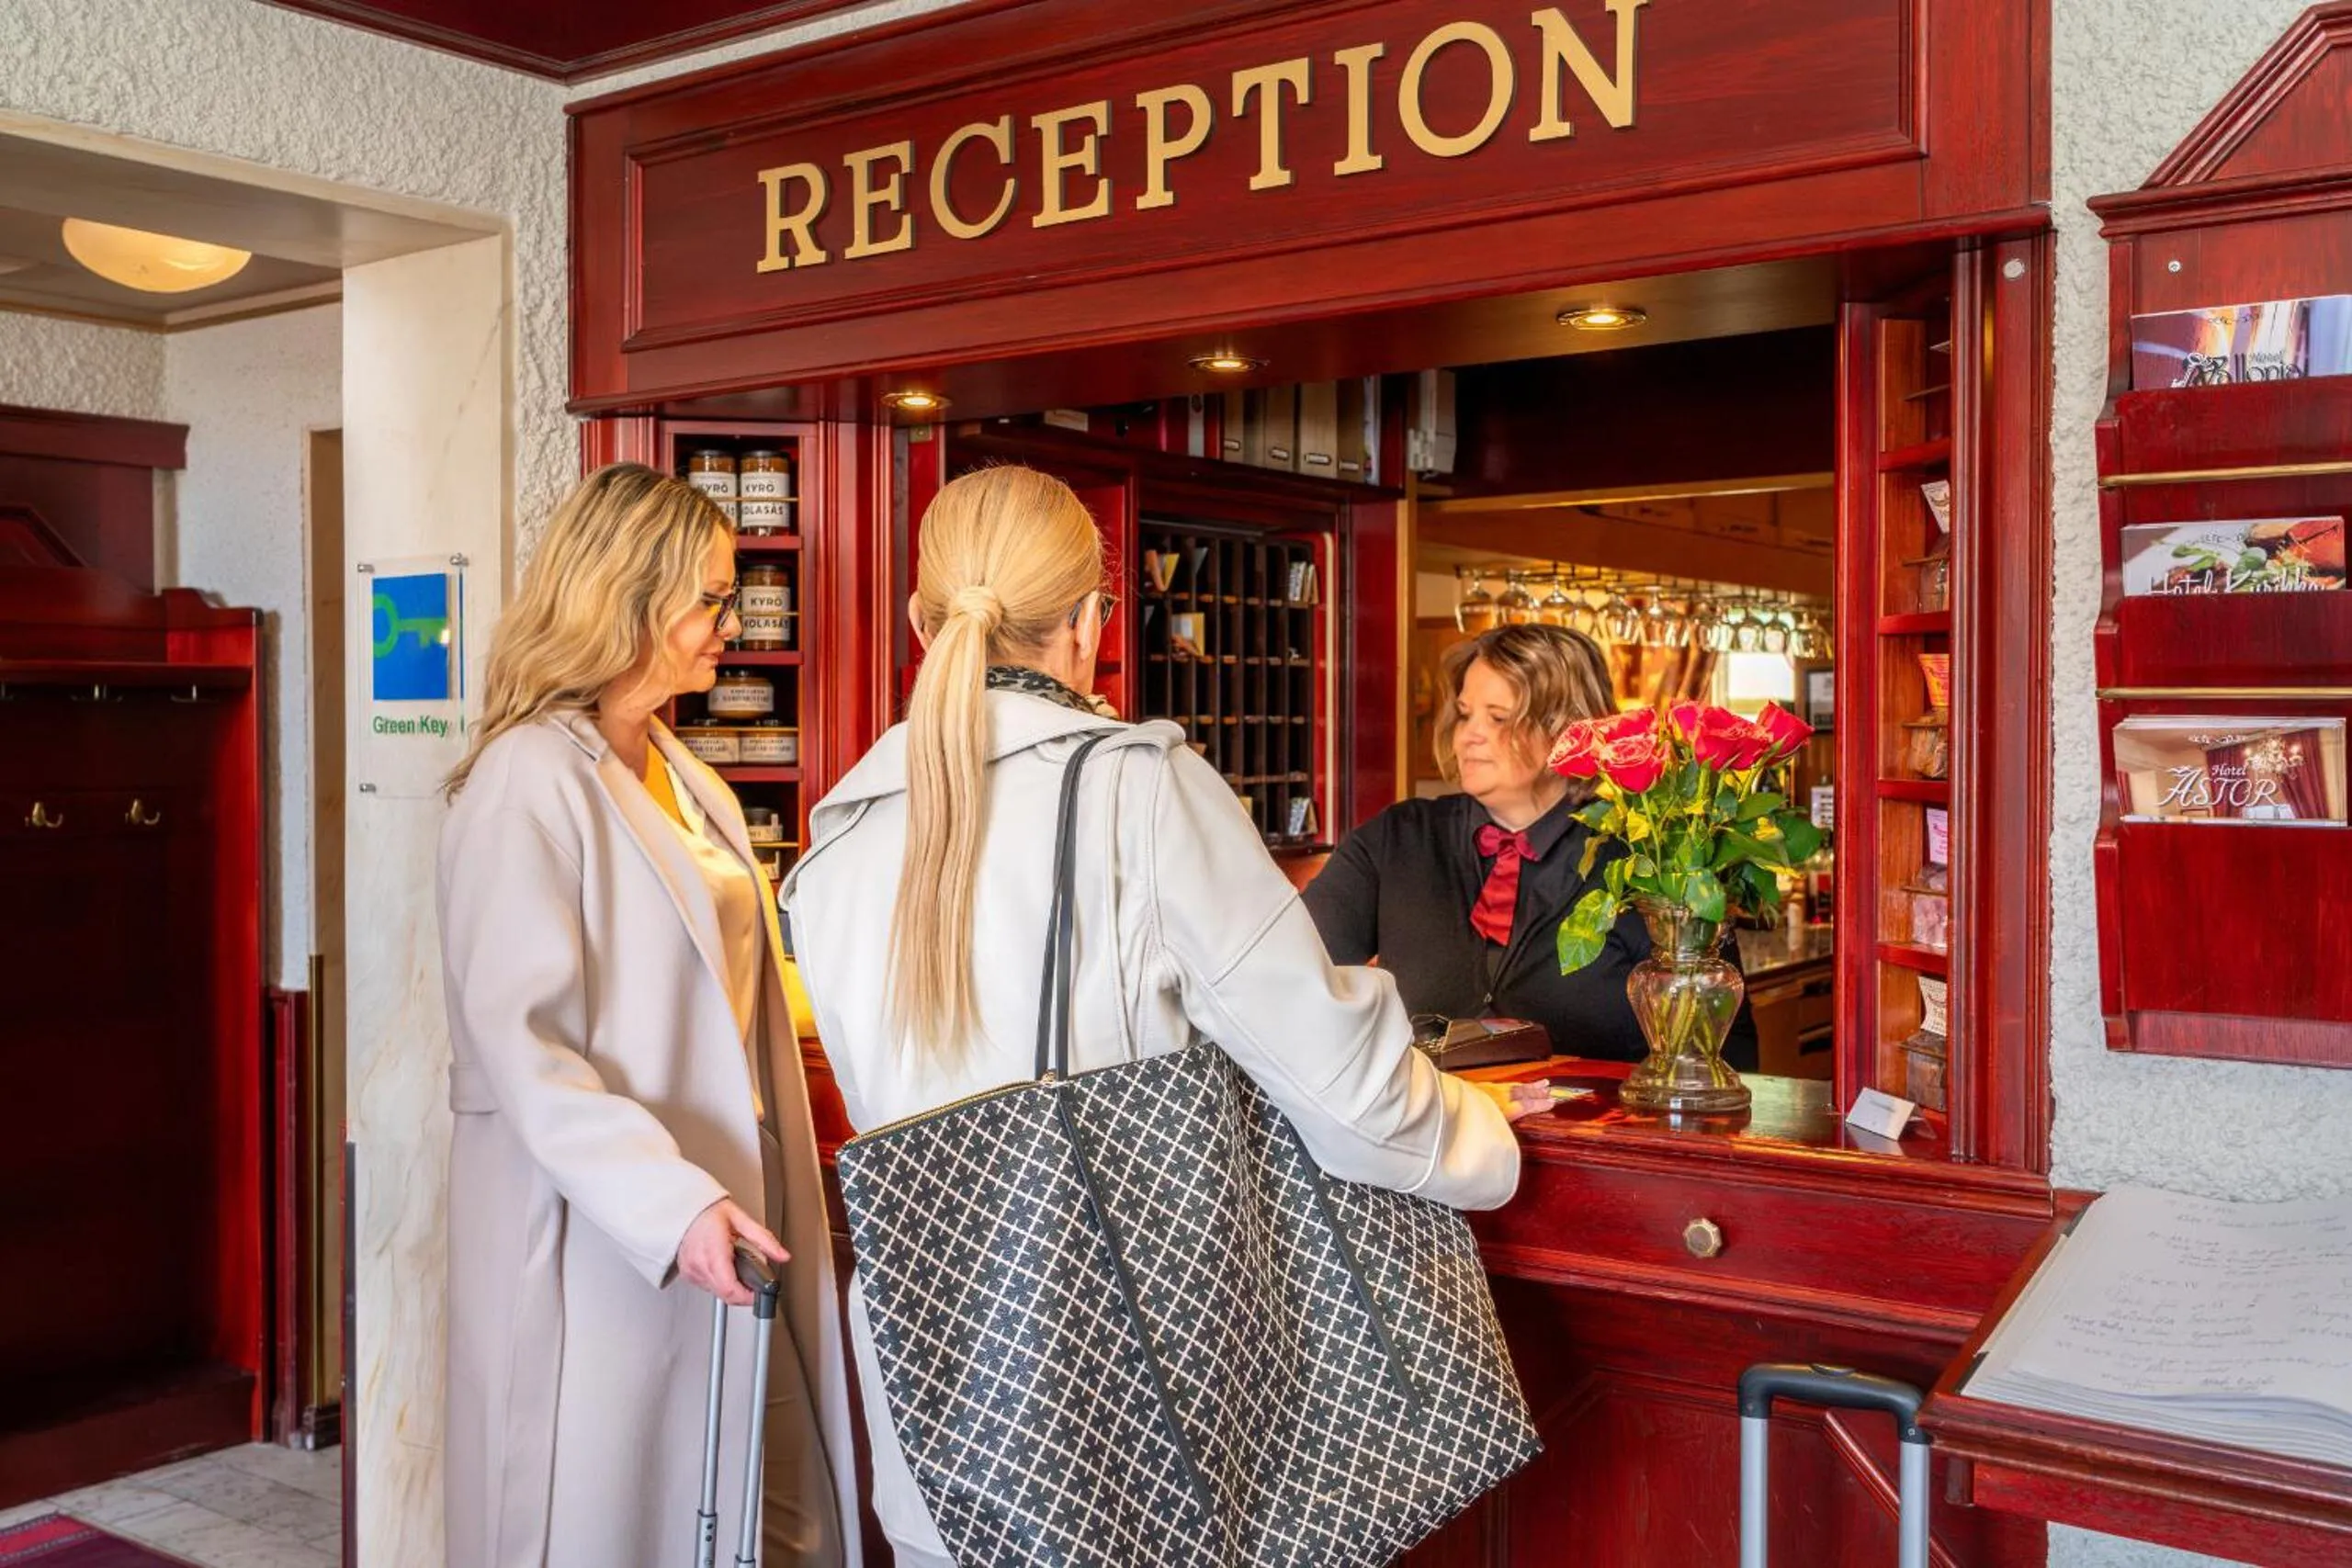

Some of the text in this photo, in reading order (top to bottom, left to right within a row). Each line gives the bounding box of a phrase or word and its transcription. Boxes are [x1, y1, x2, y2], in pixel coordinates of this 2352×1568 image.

[756, 0, 1648, 274] RECEPTION
[373, 715, 448, 739] Green Key
[2211, 762, 2246, 776] Hotel
[2155, 765, 2287, 807] ASTOR
